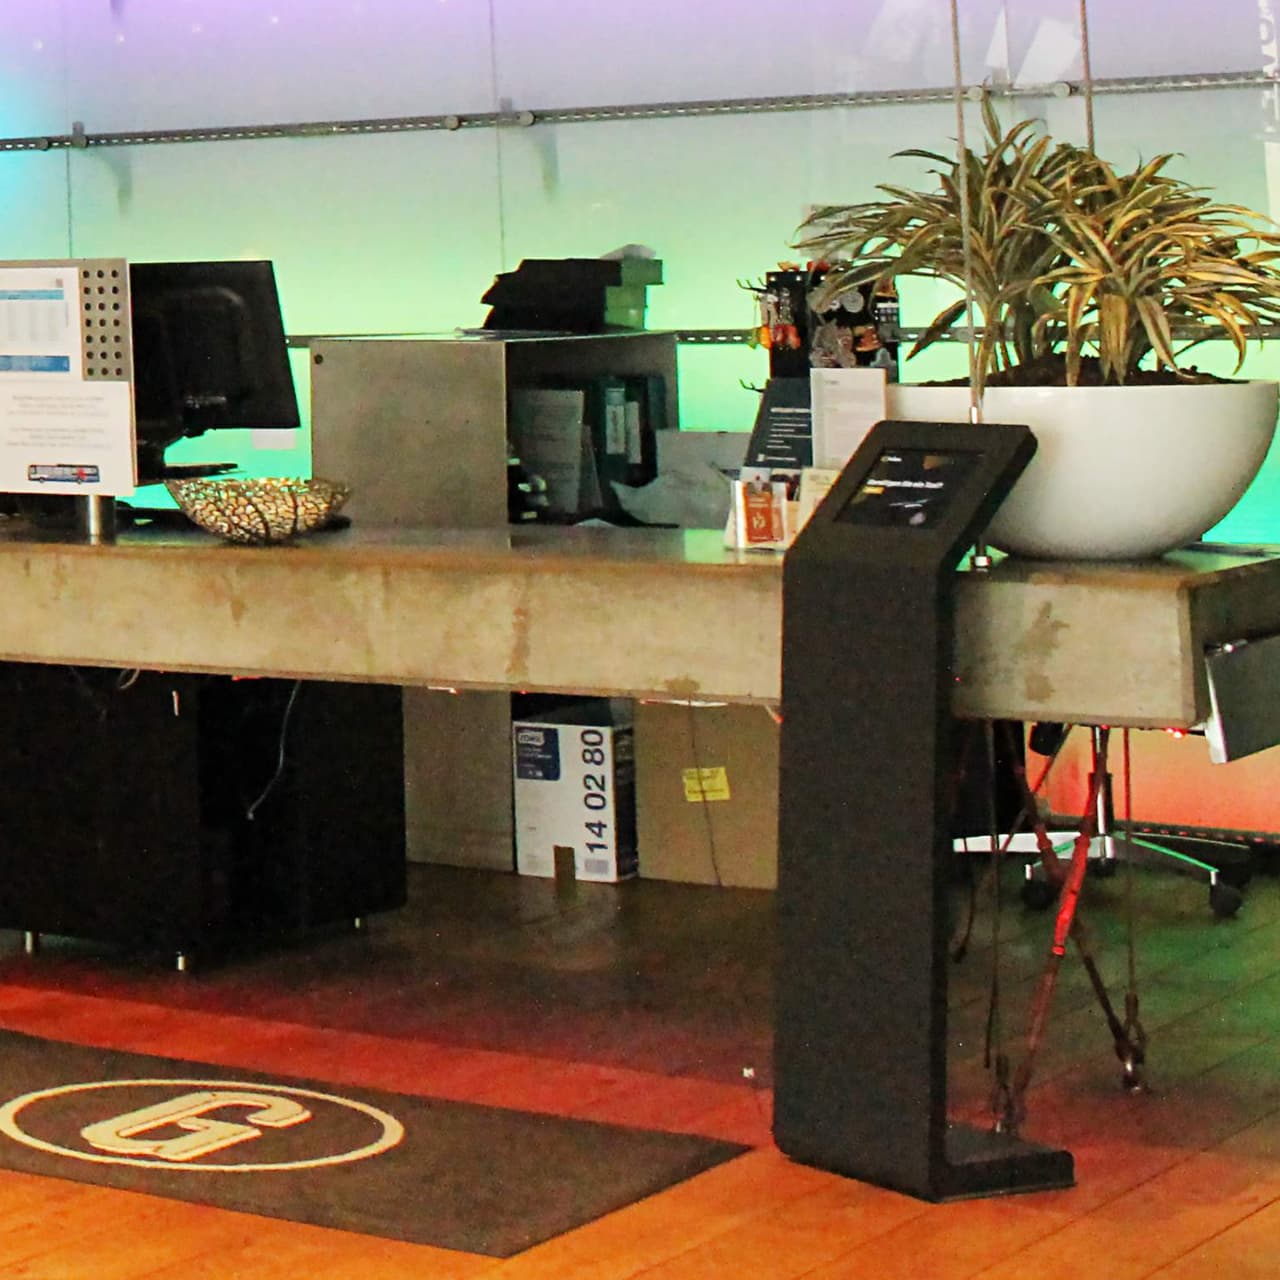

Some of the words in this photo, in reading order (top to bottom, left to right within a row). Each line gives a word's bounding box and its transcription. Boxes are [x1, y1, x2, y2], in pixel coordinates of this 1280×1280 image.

[579, 728, 606, 767] 80
[582, 773, 608, 811] 02
[584, 820, 610, 854] 14
